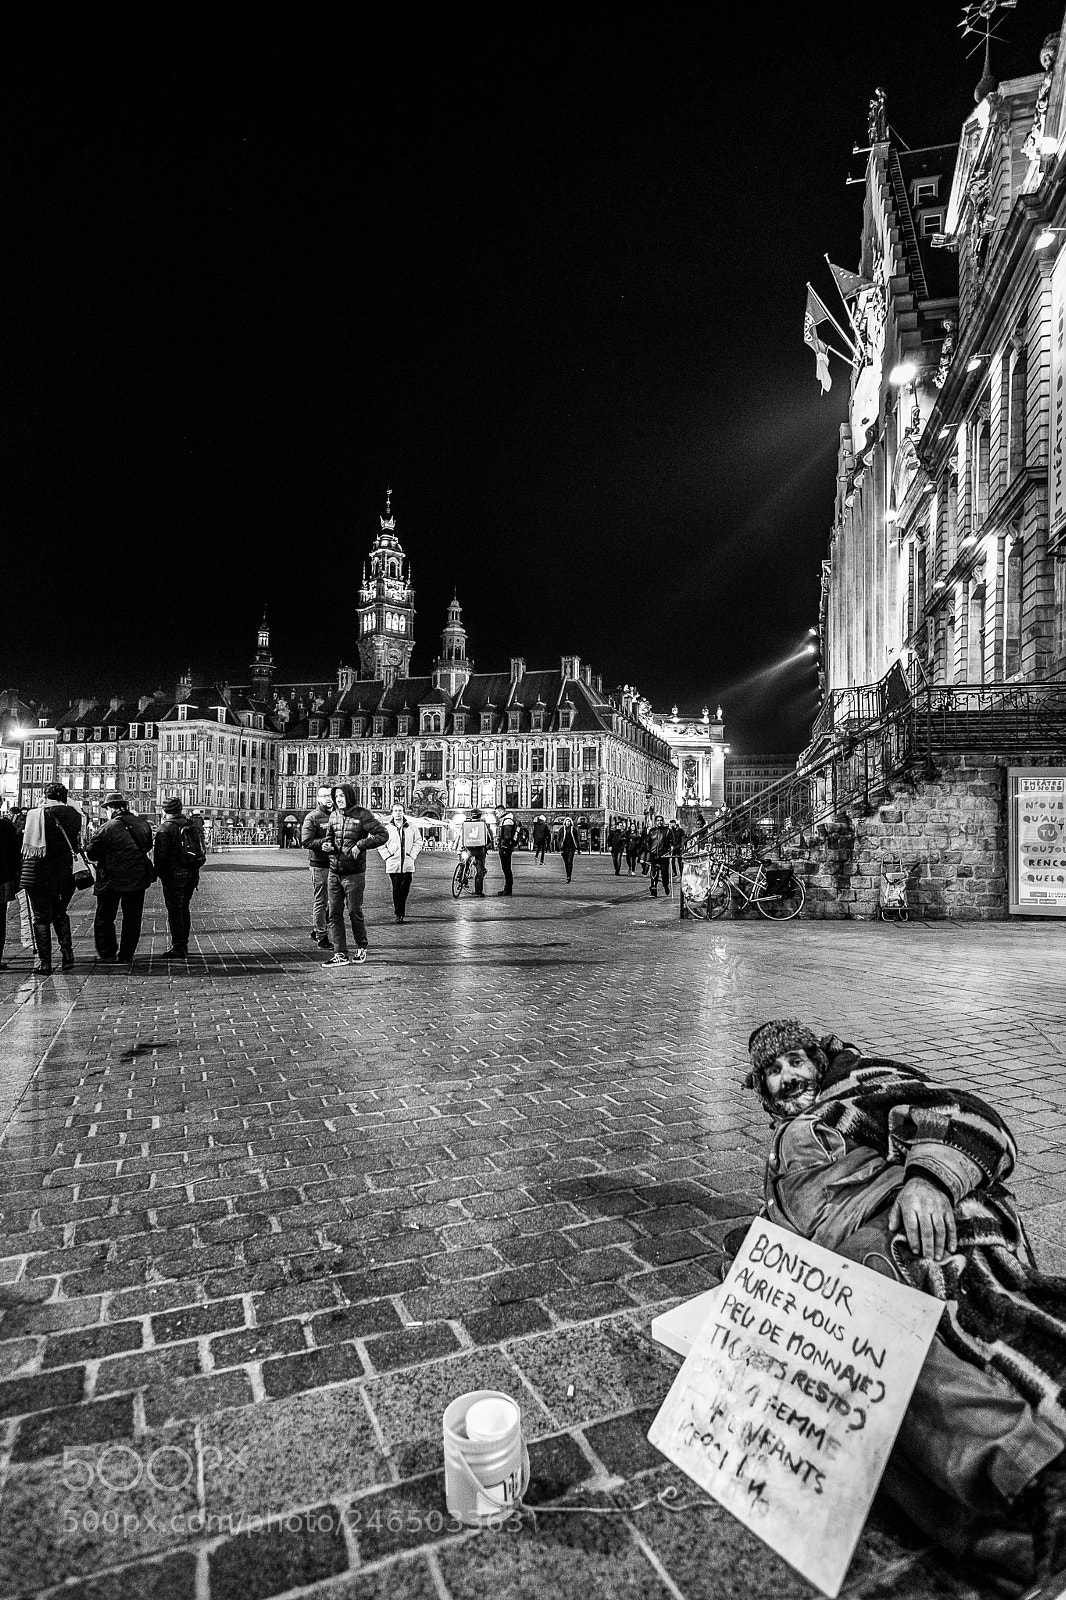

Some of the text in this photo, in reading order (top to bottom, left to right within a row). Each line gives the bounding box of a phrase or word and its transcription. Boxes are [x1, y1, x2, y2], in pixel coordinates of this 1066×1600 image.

[1040, 829, 1055, 837] TU
[749, 1233, 853, 1317] BONJOUR
[720, 1293, 756, 1329] PEU
[758, 1318, 785, 1346] DE
[734, 1267, 886, 1369] AURIEZ VOUS UN
